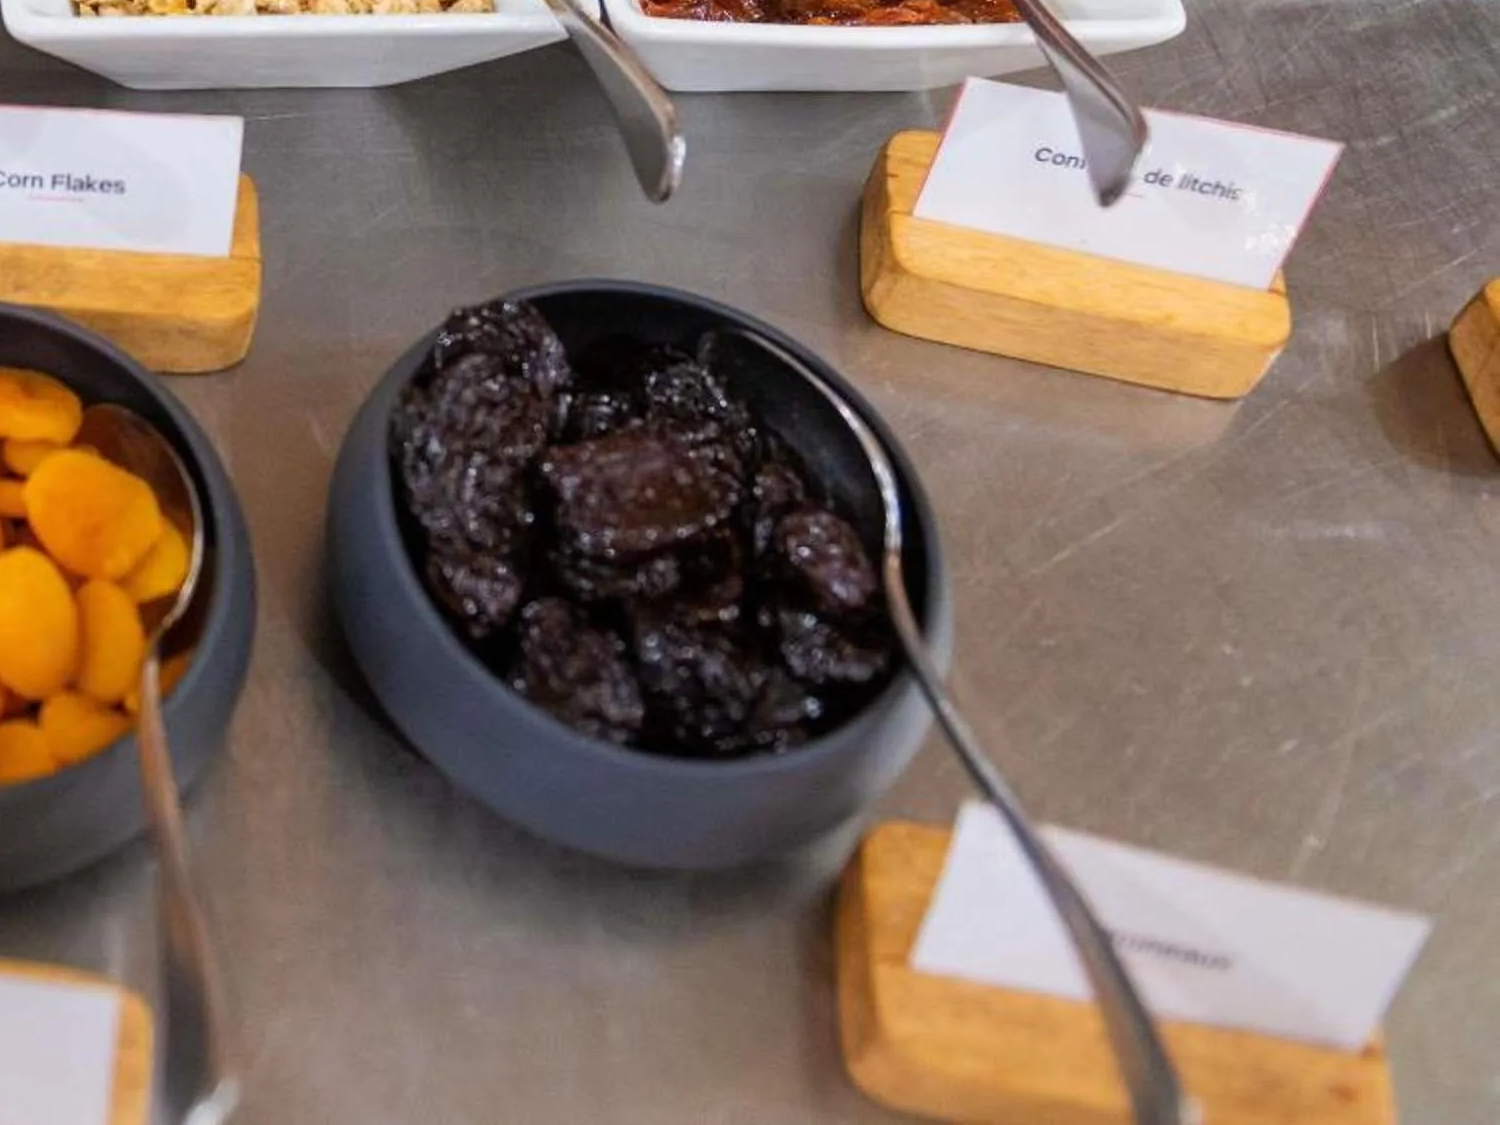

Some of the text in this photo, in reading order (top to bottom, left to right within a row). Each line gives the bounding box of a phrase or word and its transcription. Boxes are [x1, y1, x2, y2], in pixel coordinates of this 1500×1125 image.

[50, 173, 126, 195] Flakes
[1143, 168, 1243, 200] de litchis
